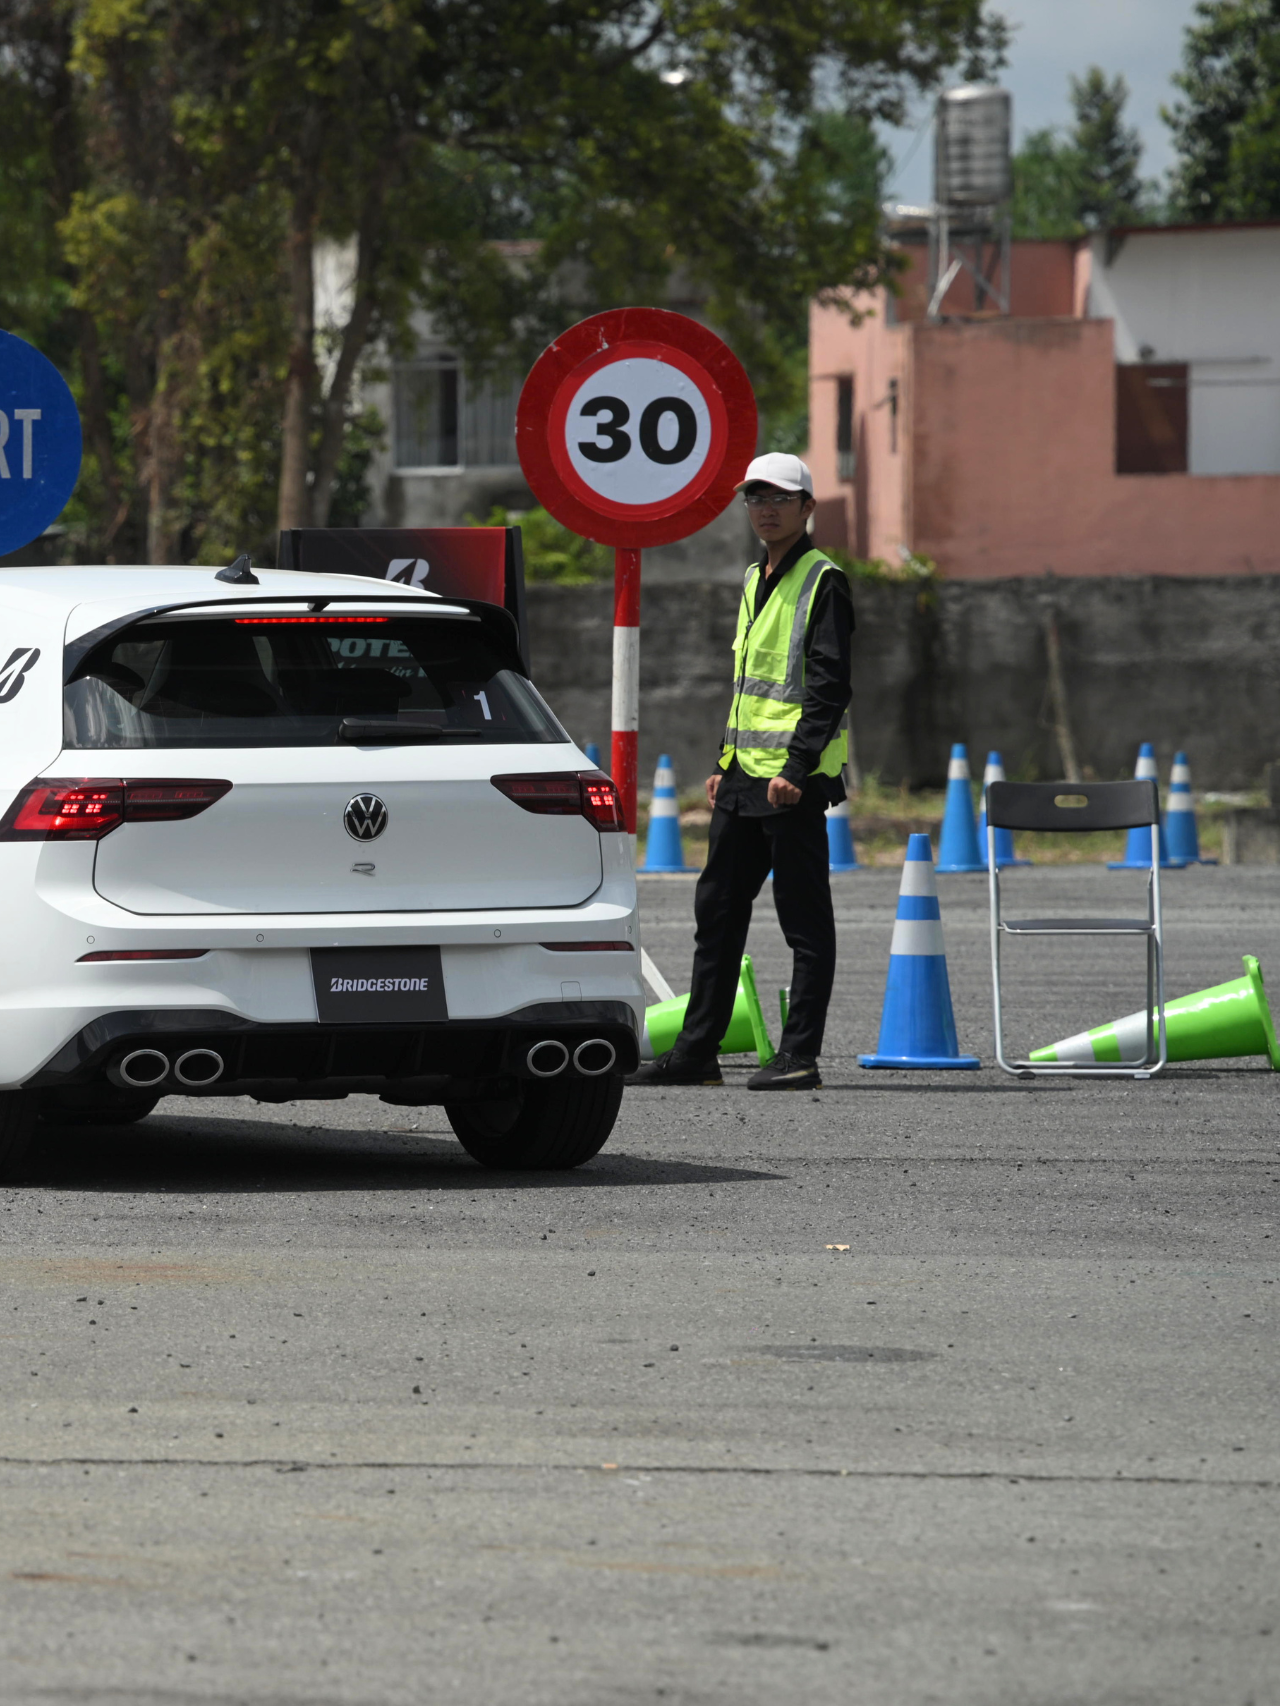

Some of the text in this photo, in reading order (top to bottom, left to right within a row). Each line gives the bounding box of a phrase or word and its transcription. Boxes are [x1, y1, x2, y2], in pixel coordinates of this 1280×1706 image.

[577, 395, 698, 466] 30
[327, 637, 414, 658] OTE
[473, 690, 492, 721] 1
[330, 977, 429, 992] BRIDGESTONE
